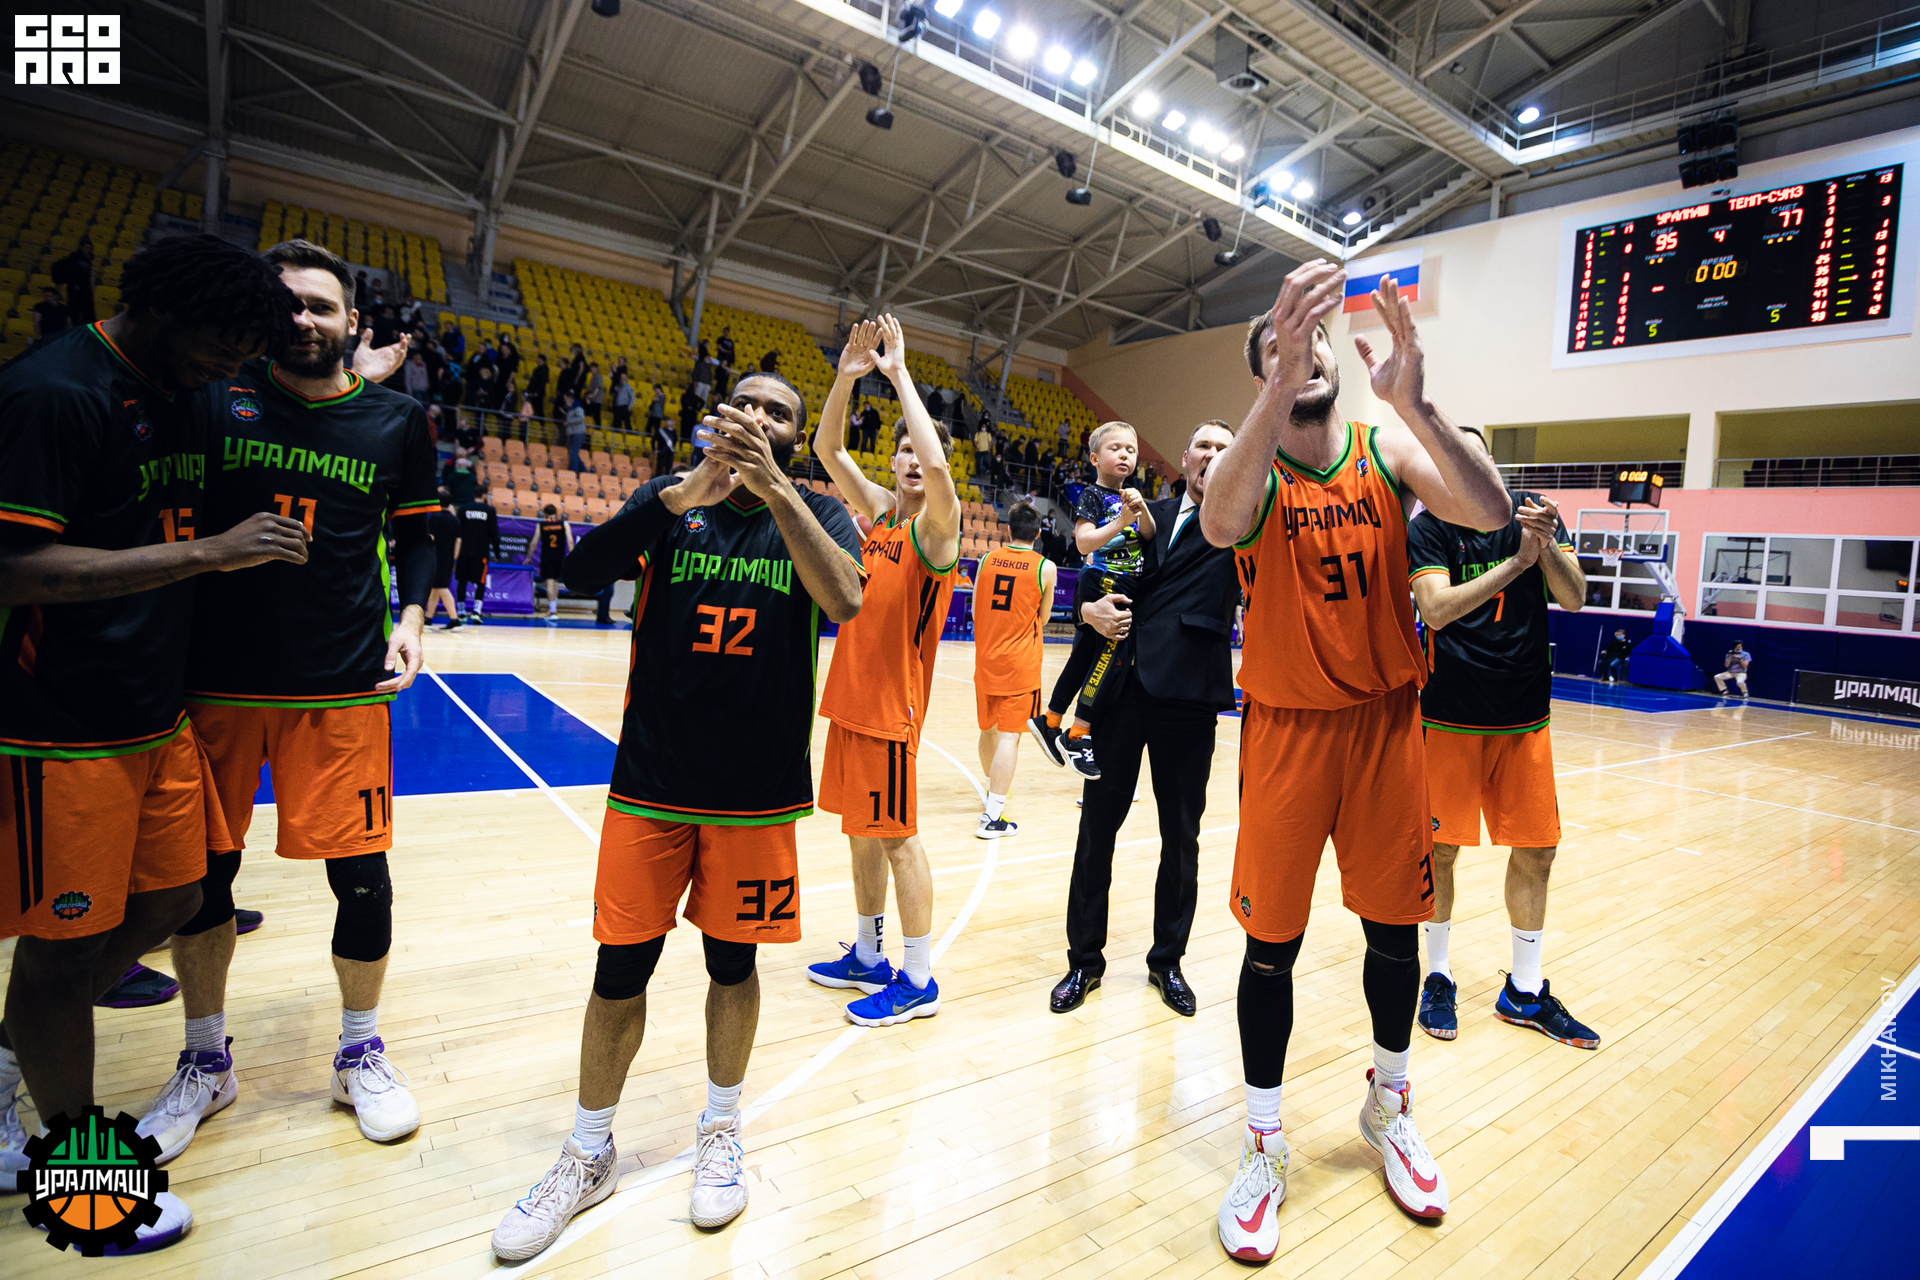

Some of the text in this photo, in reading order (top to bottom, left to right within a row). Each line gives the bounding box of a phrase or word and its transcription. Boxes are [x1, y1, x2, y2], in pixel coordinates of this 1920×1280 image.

[1656, 185, 1804, 226] УРАЛМАШ ТЕМП-СУМЗ
[1771, 203, 1799, 214] СЧЕТ
[1778, 208, 1804, 229] 77
[1655, 231, 1678, 252] 95
[1714, 229, 1726, 243] 4
[1701, 255, 1734, 266] ВРЕМЯ
[1770, 308, 1780, 323] 5
[1648, 323, 1658, 337] 5
[222, 436, 377, 494] УРАЛМАШ
[549, 534, 558, 548] 2
[670, 549, 793, 595] УРАЛМАШ
[991, 558, 1030, 571] ЗУБКОВ
[1320, 550, 1368, 603] 31
[991, 574, 1017, 612] 9
[692, 604, 757, 656] 32
[358, 786, 387, 832] 11
[869, 791, 881, 822] 1
[736, 875, 796, 922] 32
